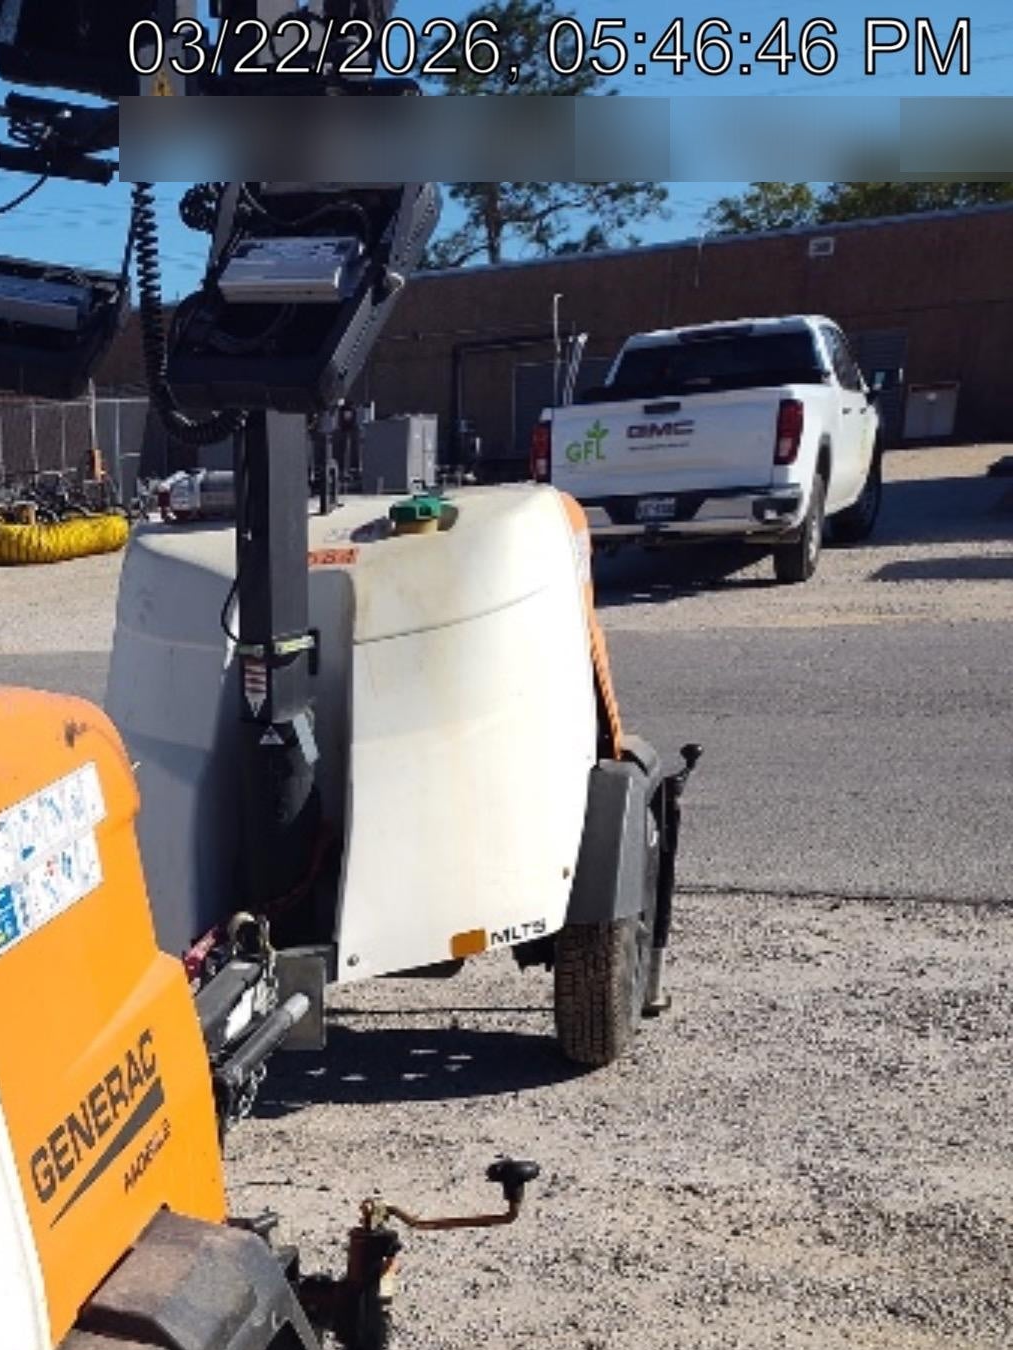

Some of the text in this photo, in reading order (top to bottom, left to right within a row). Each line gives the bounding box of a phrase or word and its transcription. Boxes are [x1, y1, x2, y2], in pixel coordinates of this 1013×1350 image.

[626, 420, 695, 438] GMC
[565, 437, 606, 462] GFL
[491, 917, 546, 946] MLTS
[30, 1029, 156, 1203] GENERAC
